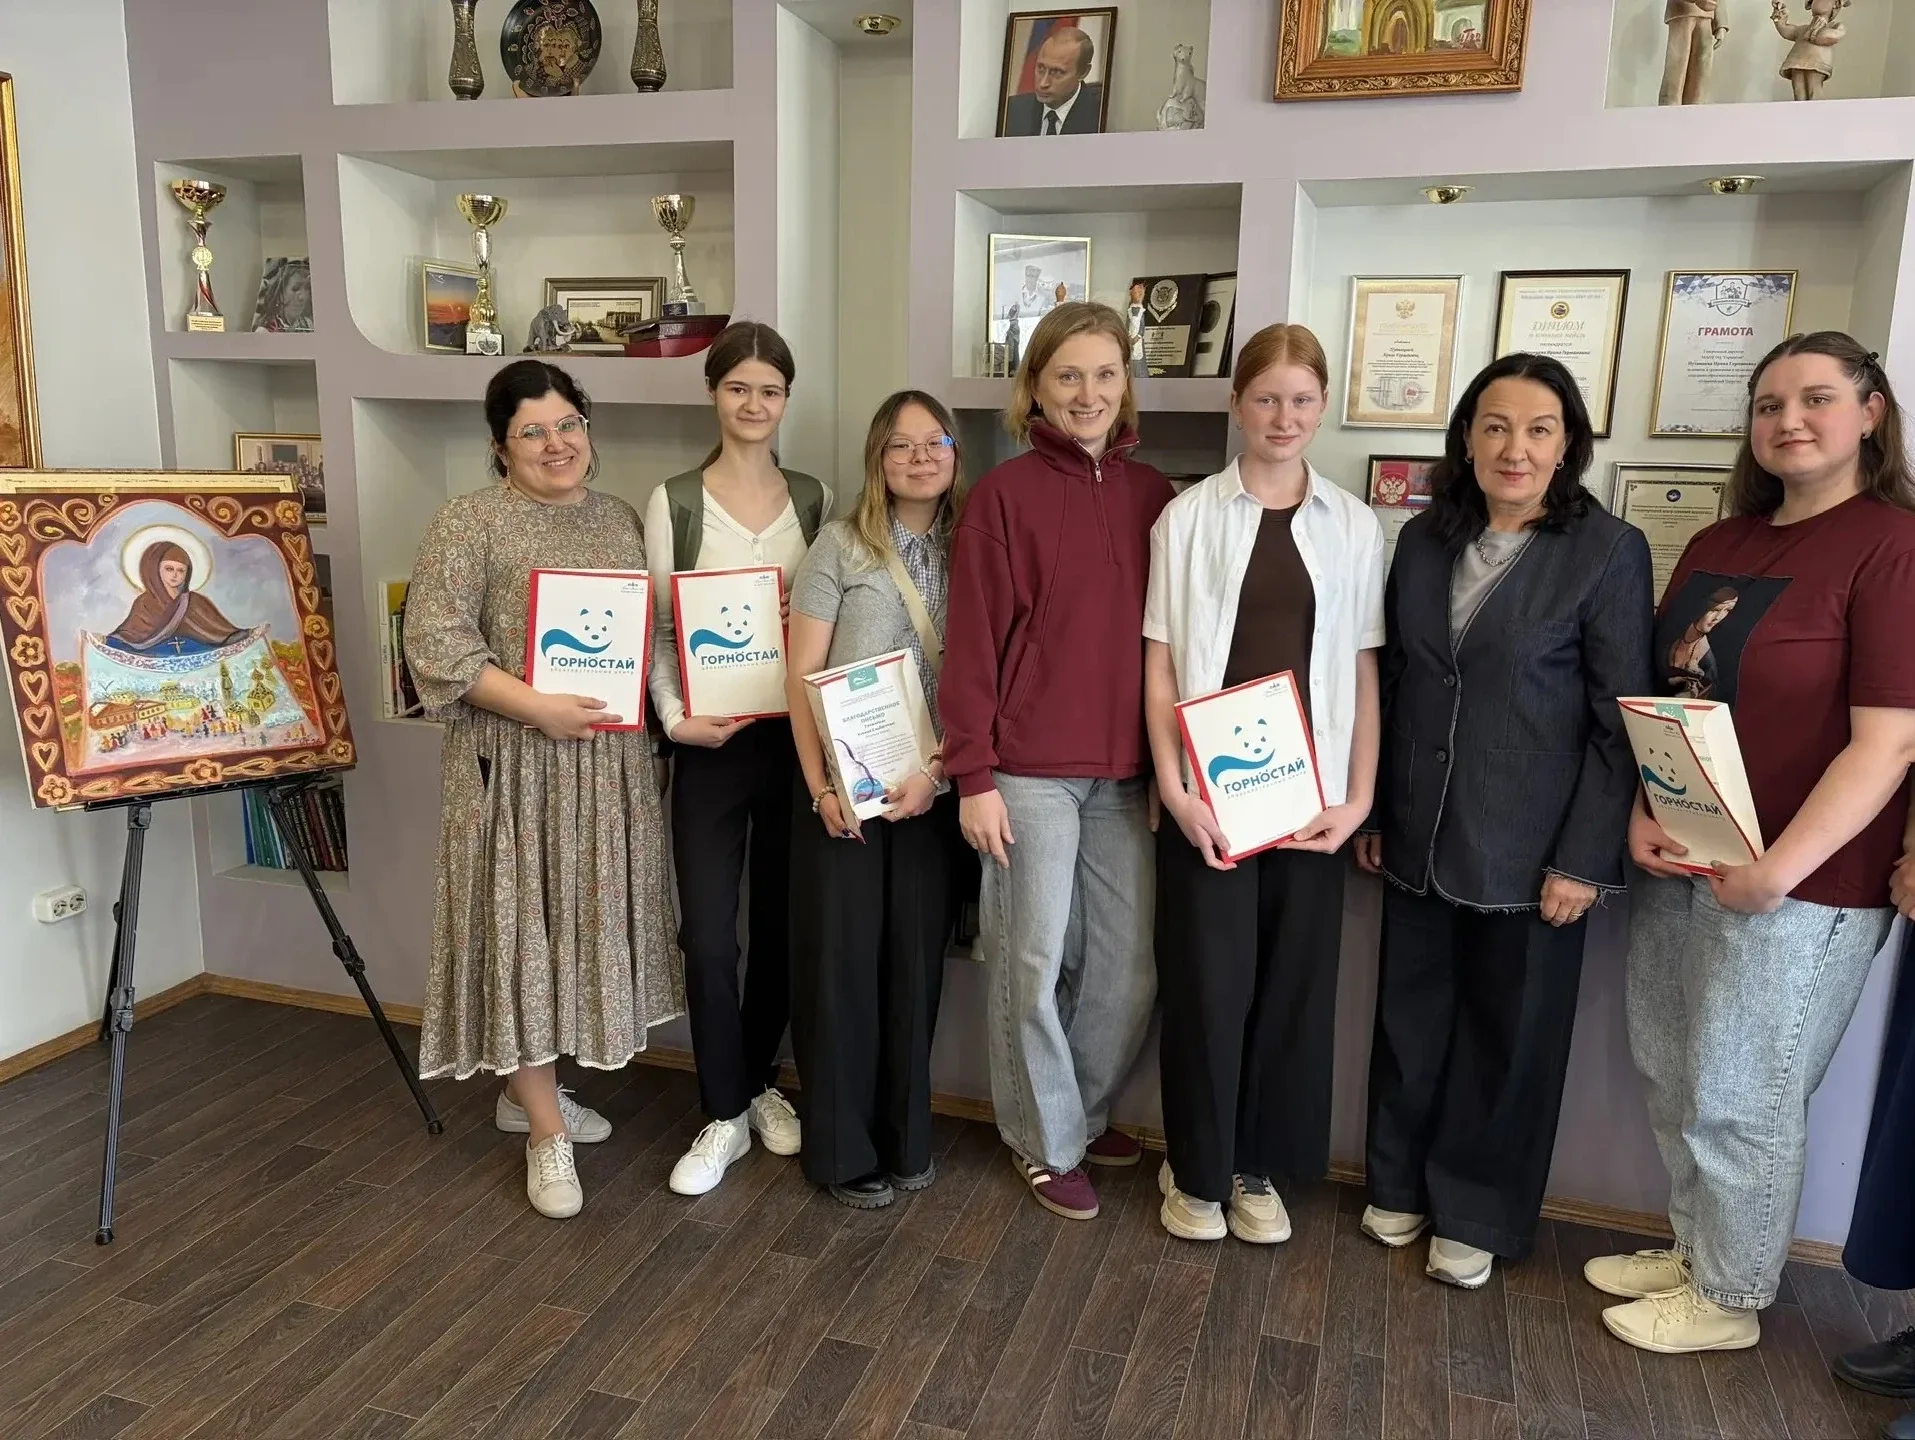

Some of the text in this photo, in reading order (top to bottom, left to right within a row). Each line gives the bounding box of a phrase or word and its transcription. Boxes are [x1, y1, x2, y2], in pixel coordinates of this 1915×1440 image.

[1698, 327, 1754, 336] ГРАМОТА
[551, 656, 635, 669] ГОРНОСТАЙ
[701, 647, 779, 666] ГОРНОСТАЙ
[842, 700, 900, 723] БЛАГОДАРСТВЕННОЕ
[860, 712, 886, 724] ПИСЬМО
[1224, 757, 1306, 795] ГОРНОСТАЙ
[1653, 792, 1723, 816] ГОРНОСТАЙ
